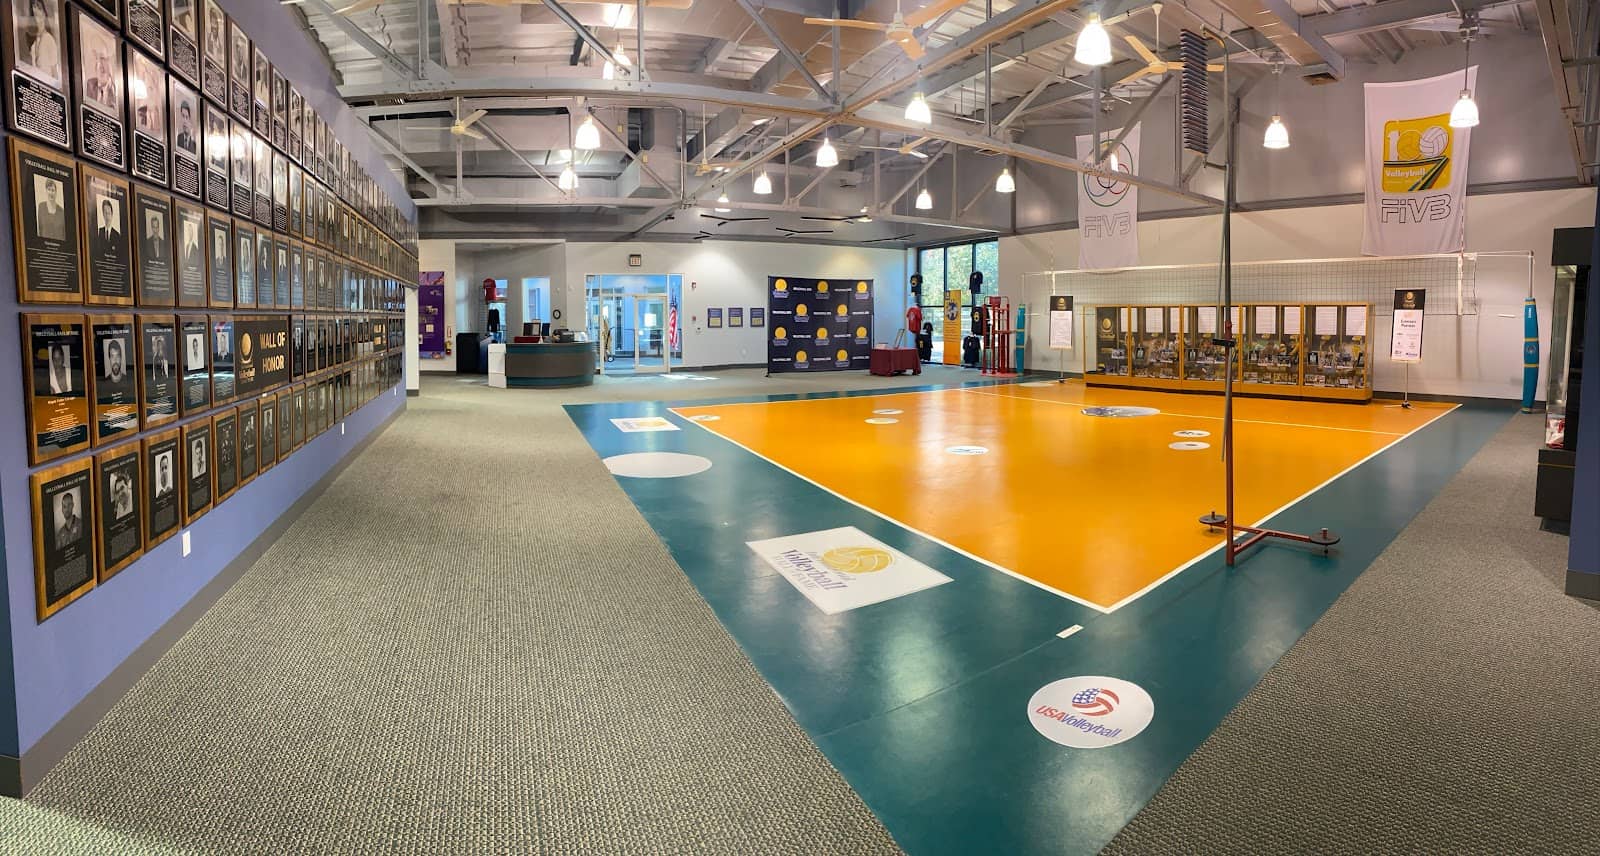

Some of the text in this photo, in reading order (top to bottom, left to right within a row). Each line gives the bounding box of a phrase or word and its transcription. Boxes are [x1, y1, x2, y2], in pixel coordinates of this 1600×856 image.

[260, 331, 286, 350] WALL OF
[262, 354, 285, 374] HONOR
[1035, 705, 1123, 738] USAVolleyball
